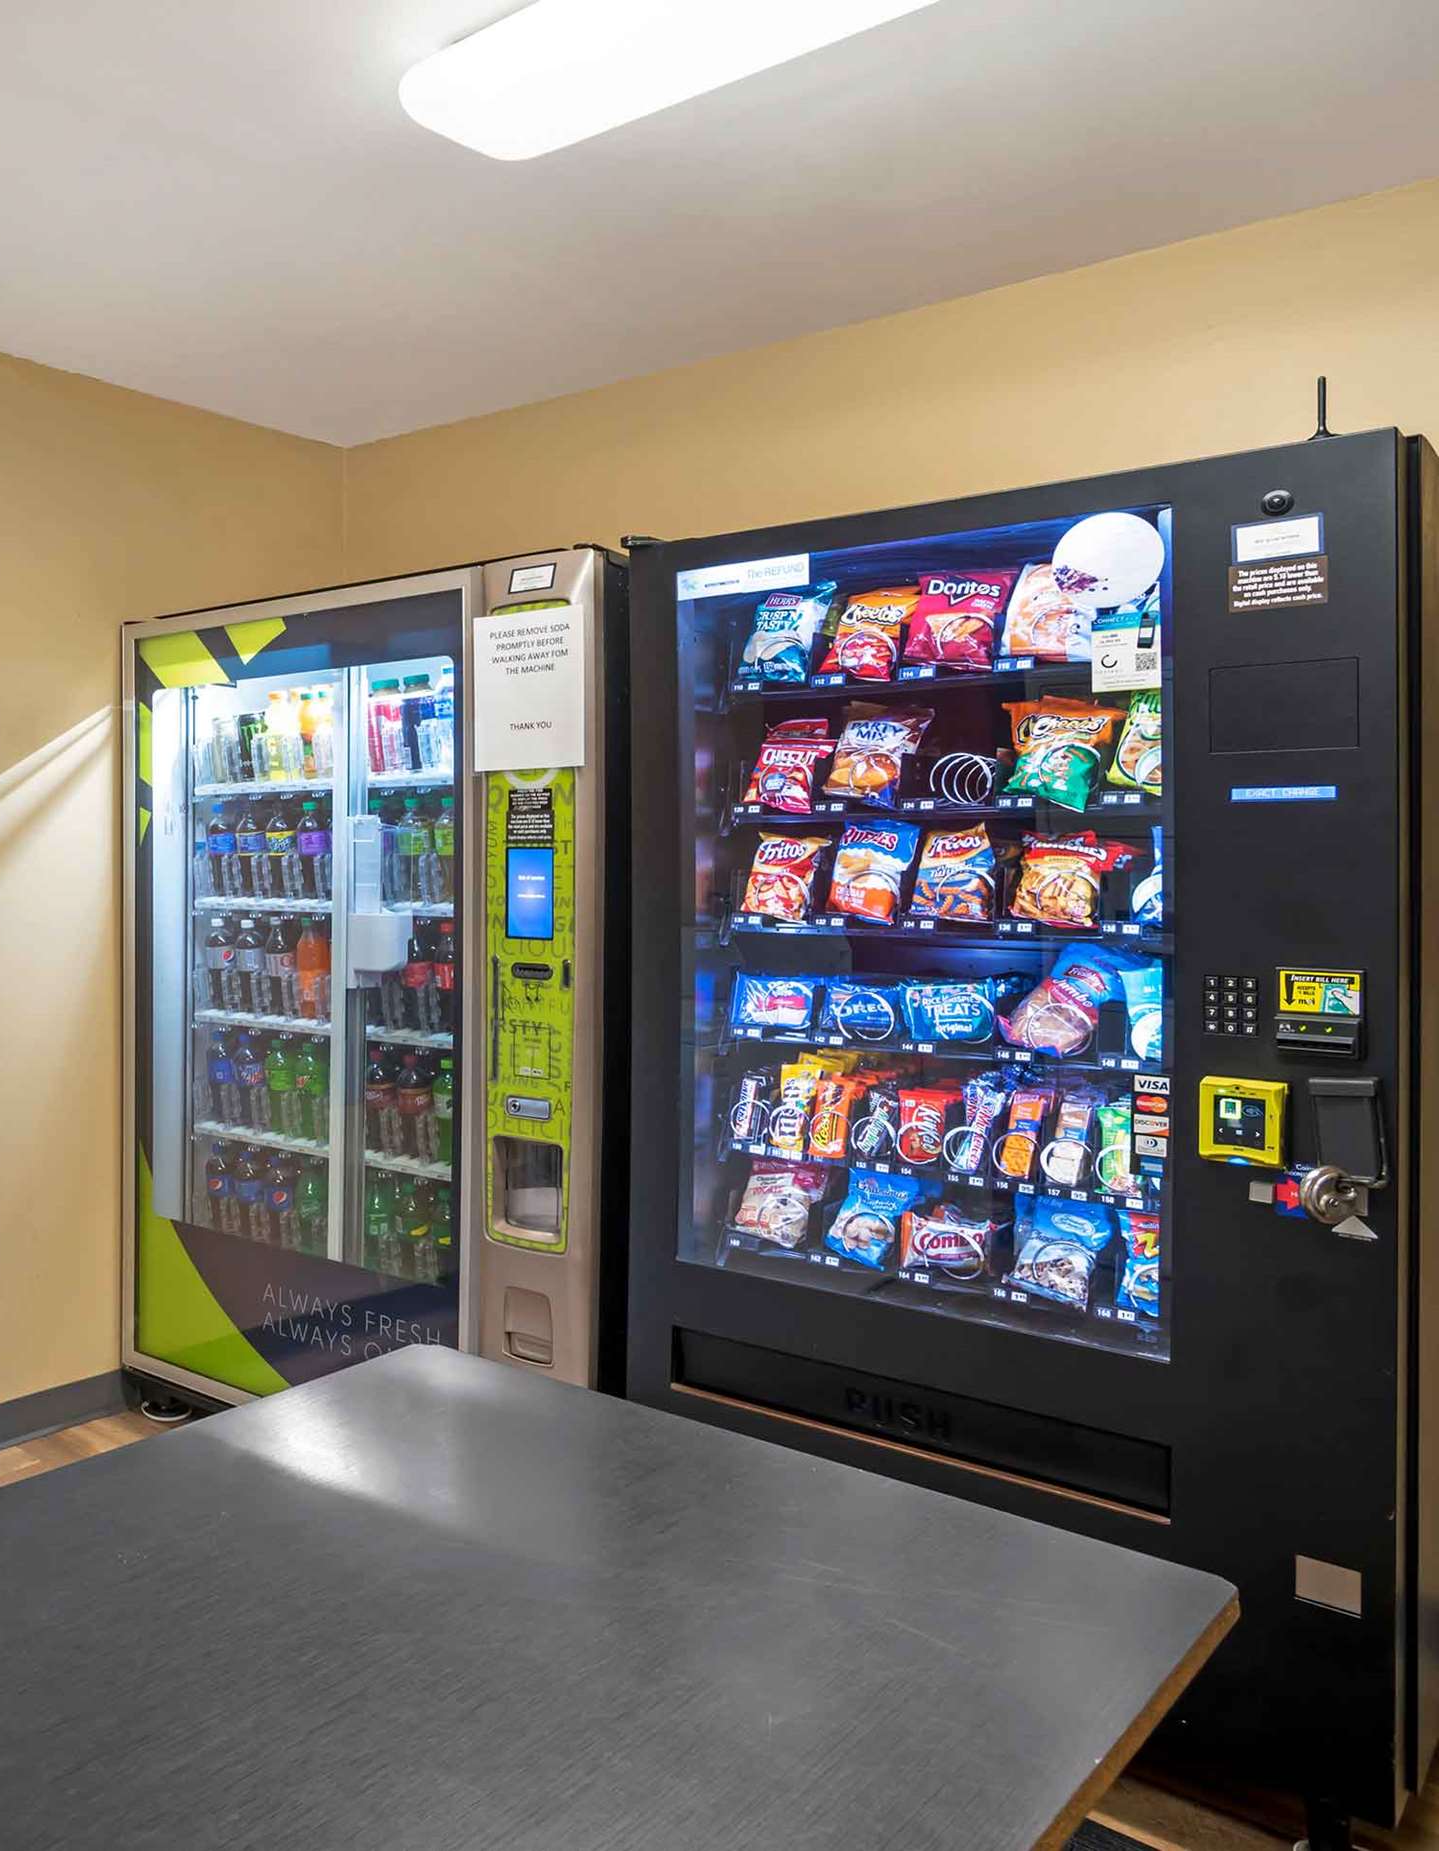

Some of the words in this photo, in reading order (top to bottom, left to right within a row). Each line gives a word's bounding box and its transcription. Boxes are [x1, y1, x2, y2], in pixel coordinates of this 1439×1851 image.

[928, 579, 1001, 599] Doritos
[489, 628, 516, 640] PLEASE
[516, 625, 548, 637] REMOVE
[550, 622, 570, 633] SODA
[495, 640, 535, 652] PROMPTLY
[536, 636, 564, 647] BEFORE
[491, 652, 527, 665] WALKING
[527, 651, 550, 661] AWAY
[551, 648, 569, 659] FOM
[505, 666, 520, 676] THE
[521, 663, 556, 675] MACHINE
[509, 722, 535, 732] THANK
[535, 721, 553, 731] YOU
[850, 721, 904, 735] PARTY
[855, 729, 889, 742] MIX
[841, 826, 898, 852] RUFFLES
[759, 840, 807, 863] Fritos
[1290, 974, 1315, 983] INSERT
[1052, 979, 1094, 1007] Jumbo
[832, 1002, 890, 1018] OREO
[925, 1003, 981, 1017] TREATS
[1138, 1079, 1169, 1091] VISA
[1135, 1118, 1168, 1128] DISCOVER
[1047, 1188, 1060, 1196] 157
[262, 1283, 353, 1327] ALWAYS
[365, 1310, 441, 1345] FRESH
[262, 1312, 352, 1356] ALWAYS
[846, 1387, 952, 1438] PUSH
